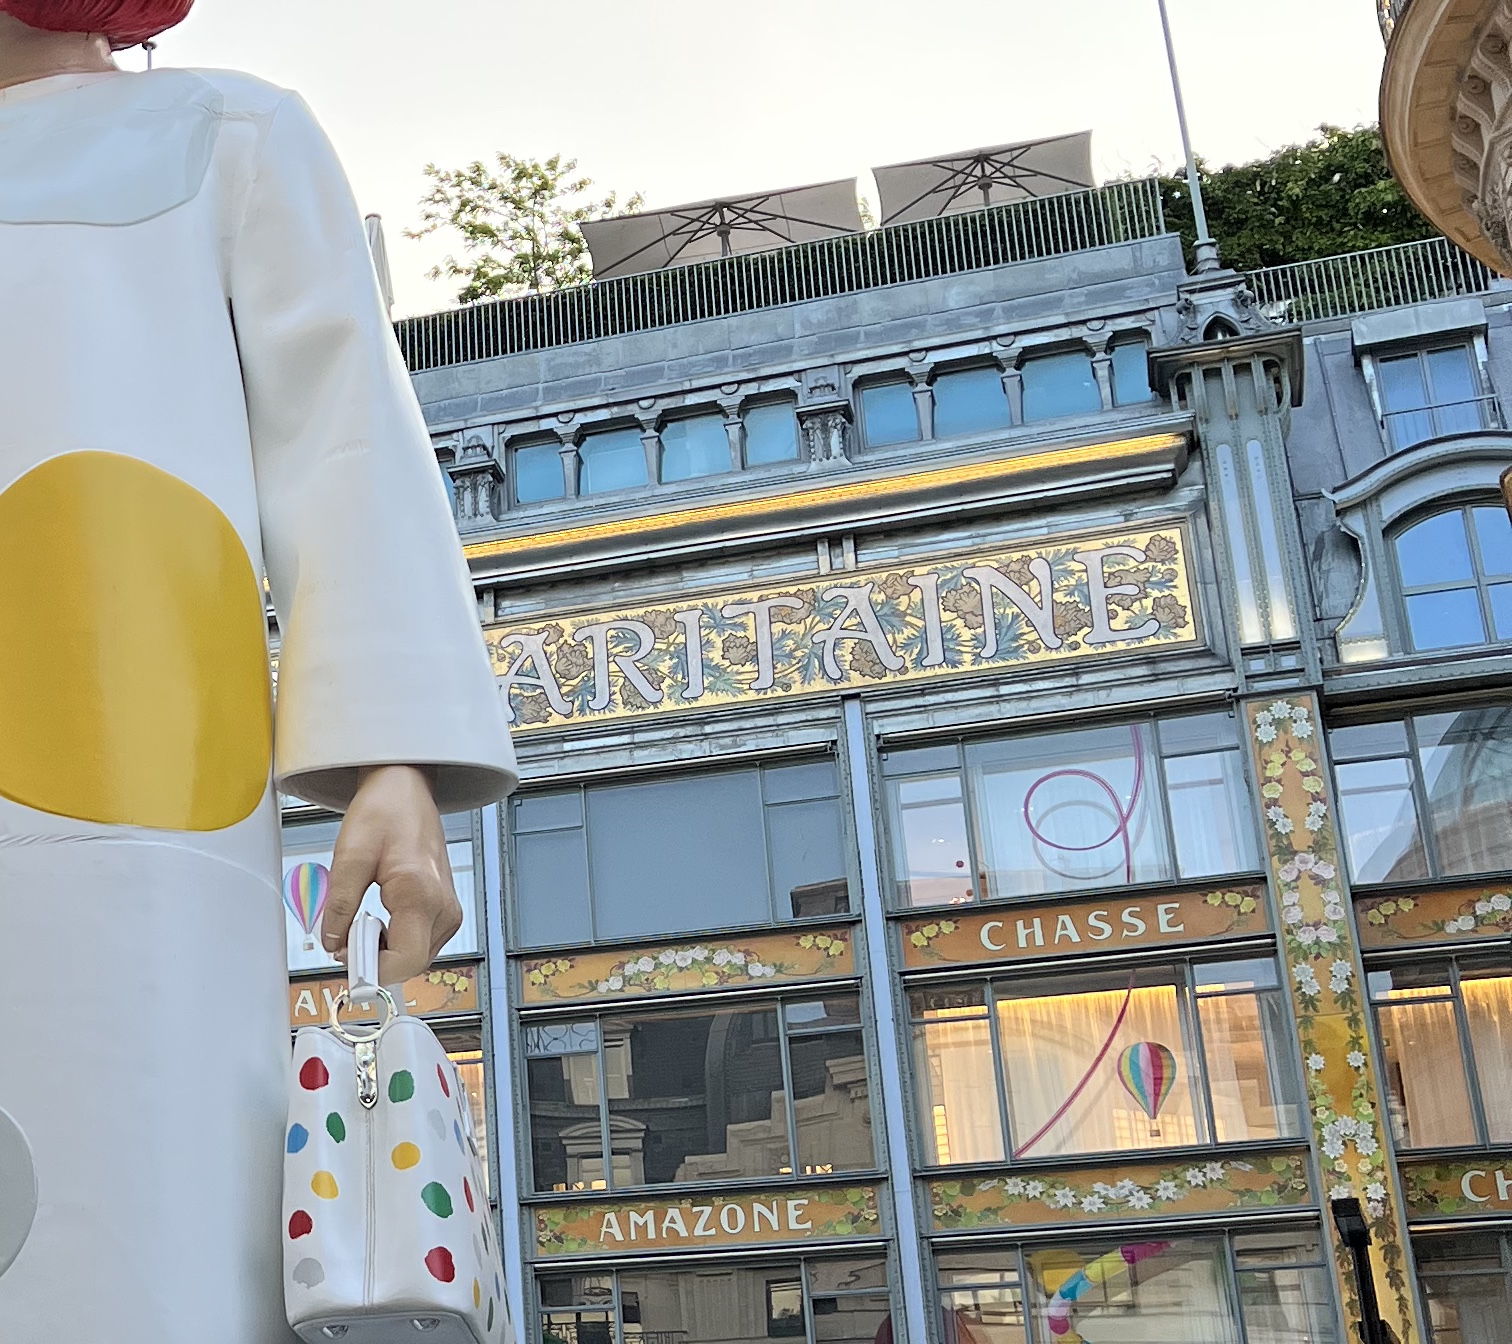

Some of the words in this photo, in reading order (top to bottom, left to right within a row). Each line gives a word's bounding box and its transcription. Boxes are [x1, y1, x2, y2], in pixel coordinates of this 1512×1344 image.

[498, 545, 1161, 723] ARITAINE
[980, 903, 1184, 951] CHASSE
[1461, 1169, 1512, 1203] CH
[599, 1199, 812, 1242] AMAZONE
